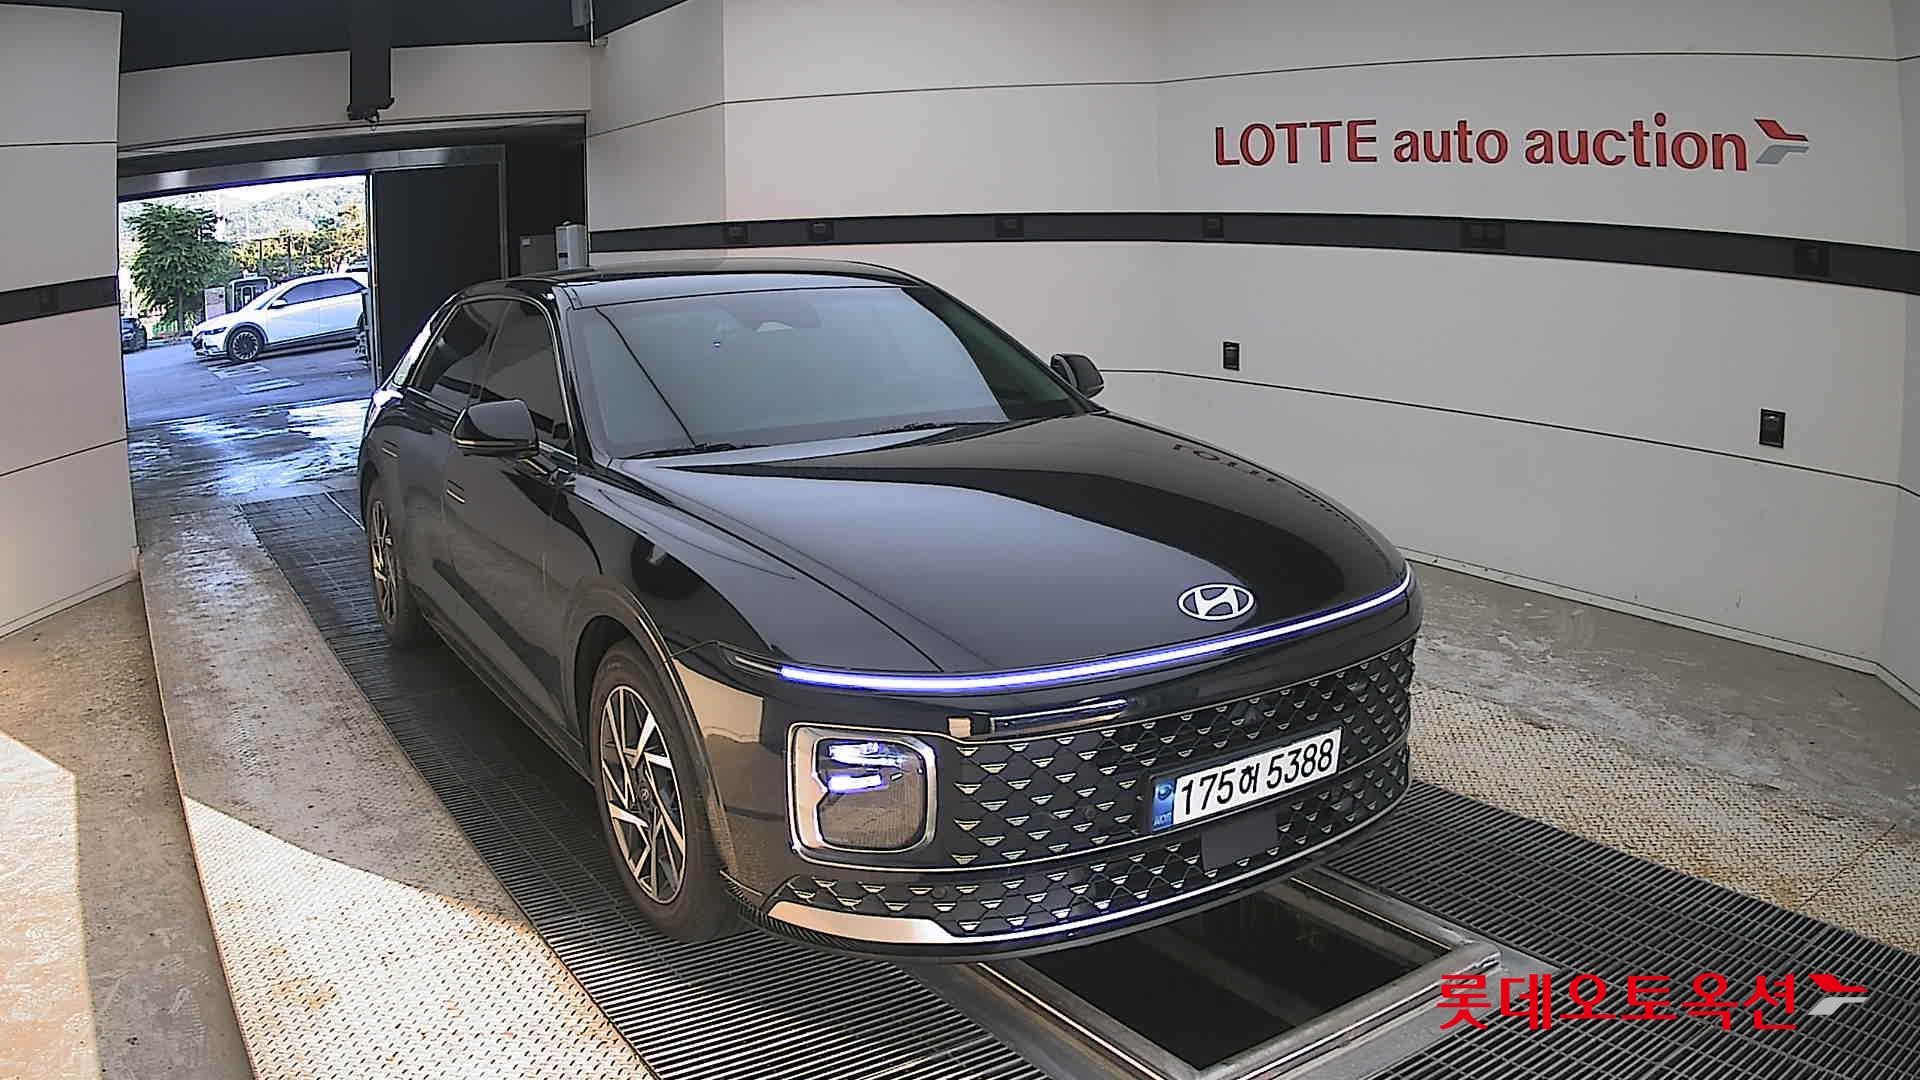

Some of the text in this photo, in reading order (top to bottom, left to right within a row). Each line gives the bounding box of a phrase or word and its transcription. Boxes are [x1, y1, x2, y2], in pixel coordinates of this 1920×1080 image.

[1214, 112, 1748, 172] LOTTE auto auction
[1181, 738, 1334, 815] 175허 5388
